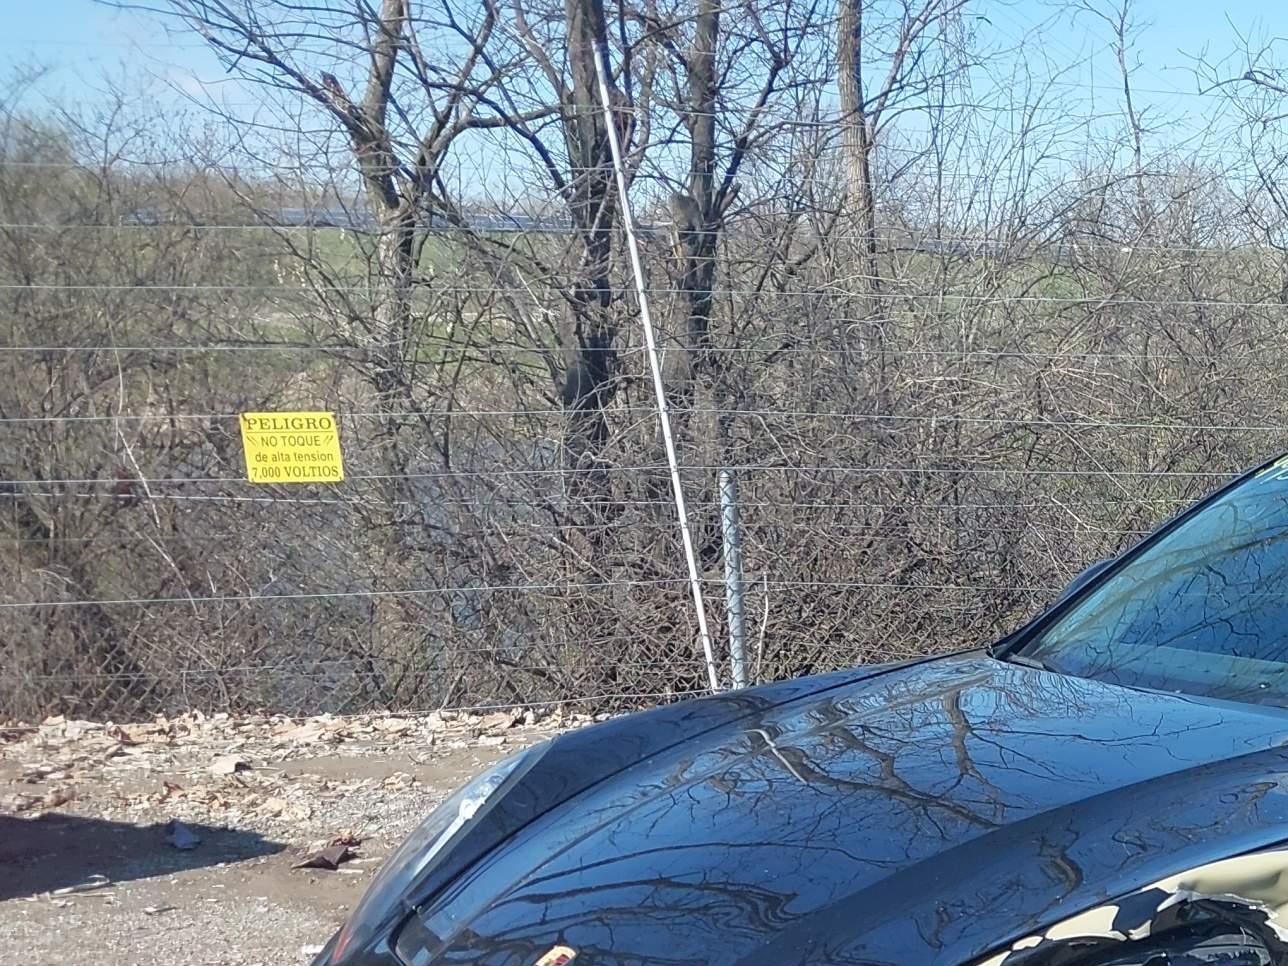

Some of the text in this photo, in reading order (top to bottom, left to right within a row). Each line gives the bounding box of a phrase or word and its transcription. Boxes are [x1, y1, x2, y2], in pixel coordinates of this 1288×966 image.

[247, 417, 332, 430] PELIGRO
[261, 435, 321, 447] NO TOQUE
[255, 450, 334, 462] de alta tension
[284, 465, 339, 478] VOLTIOS
